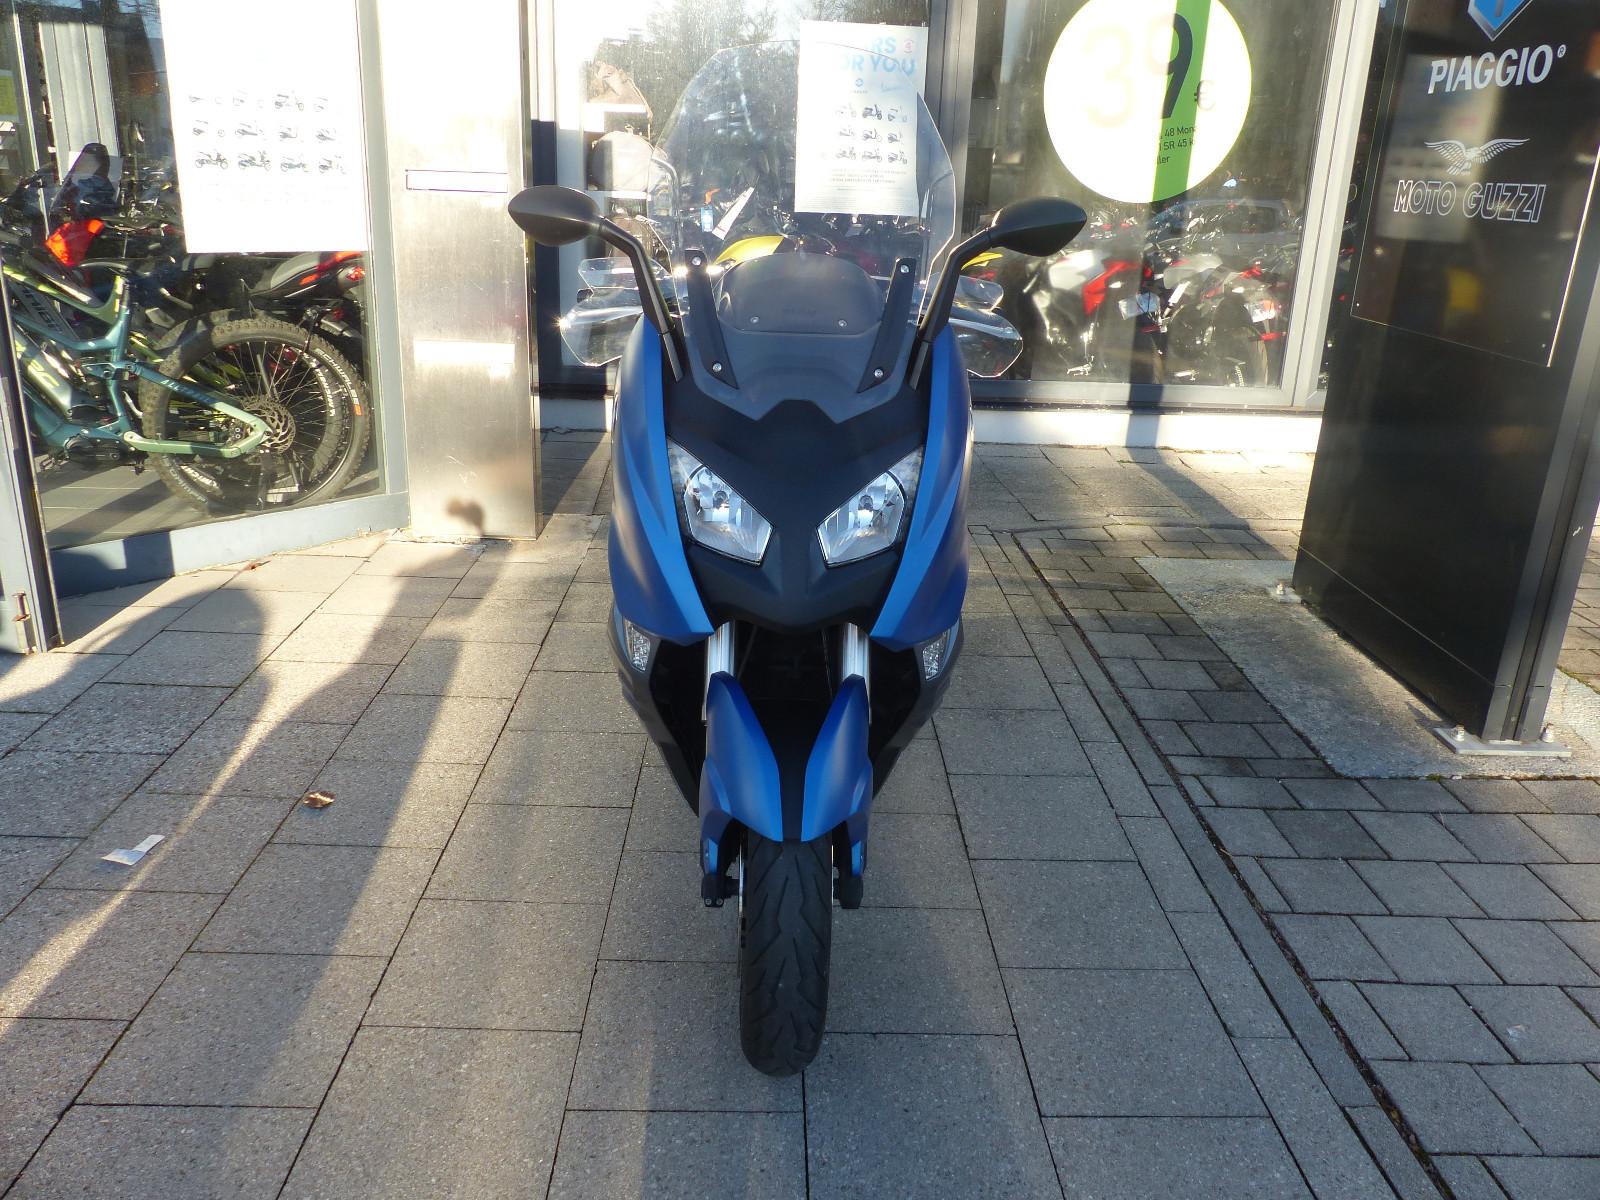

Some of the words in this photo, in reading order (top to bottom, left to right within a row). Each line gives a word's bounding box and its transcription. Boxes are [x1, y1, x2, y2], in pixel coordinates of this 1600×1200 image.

[870, 55, 916, 76] YOU
[1164, 127, 1175, 137] 48
[1163, 140, 1175, 151] SR
[1177, 138, 1188, 148] 45
[1393, 180, 1457, 216] MOTO
[1462, 182, 1547, 223] GUZZI
[314, 347, 360, 405] SCHWALBE
